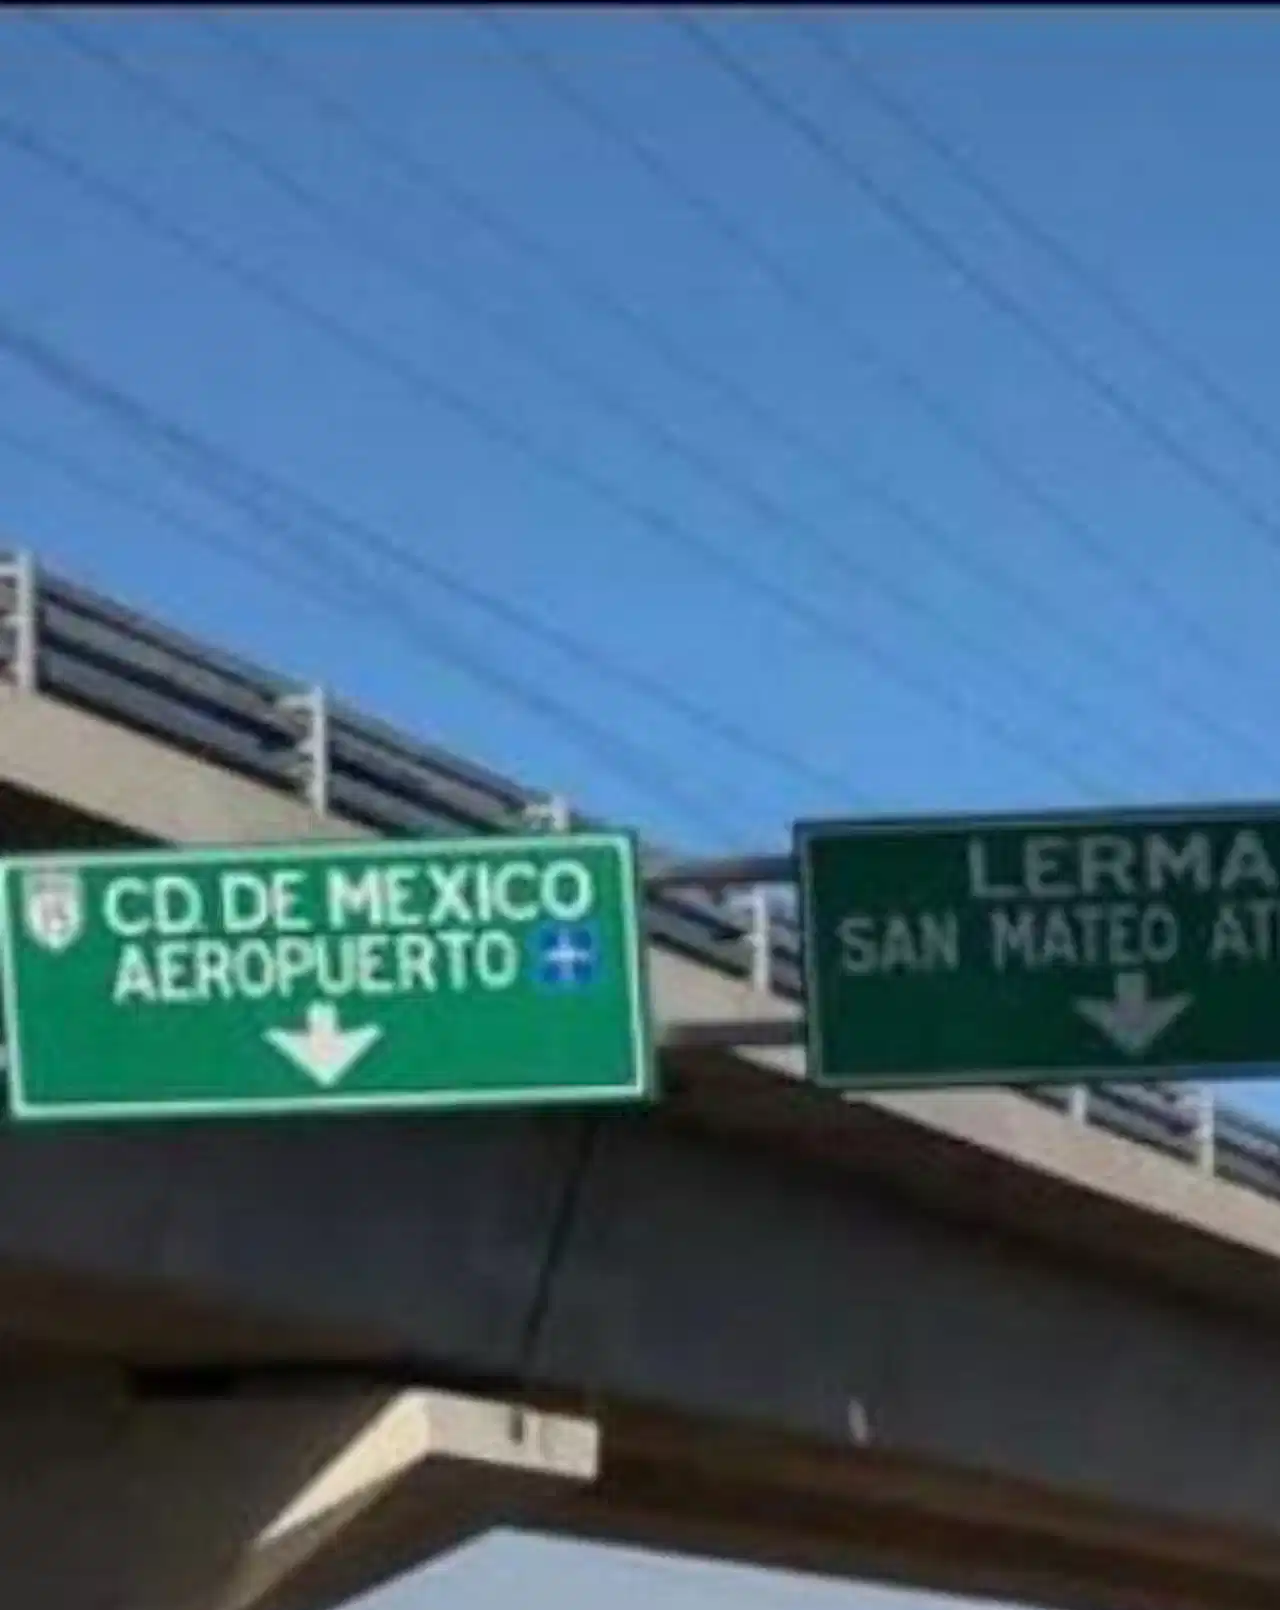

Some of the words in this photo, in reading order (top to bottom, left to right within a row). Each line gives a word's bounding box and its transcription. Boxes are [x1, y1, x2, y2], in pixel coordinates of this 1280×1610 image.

[221, 869, 313, 931] DE
[325, 859, 595, 929] MEXICO
[967, 830, 1280, 899] LERMA
[112, 928, 519, 1004] AEROPUERTO
[837, 912, 960, 975] SAN
[989, 903, 1180, 968] MATEO
